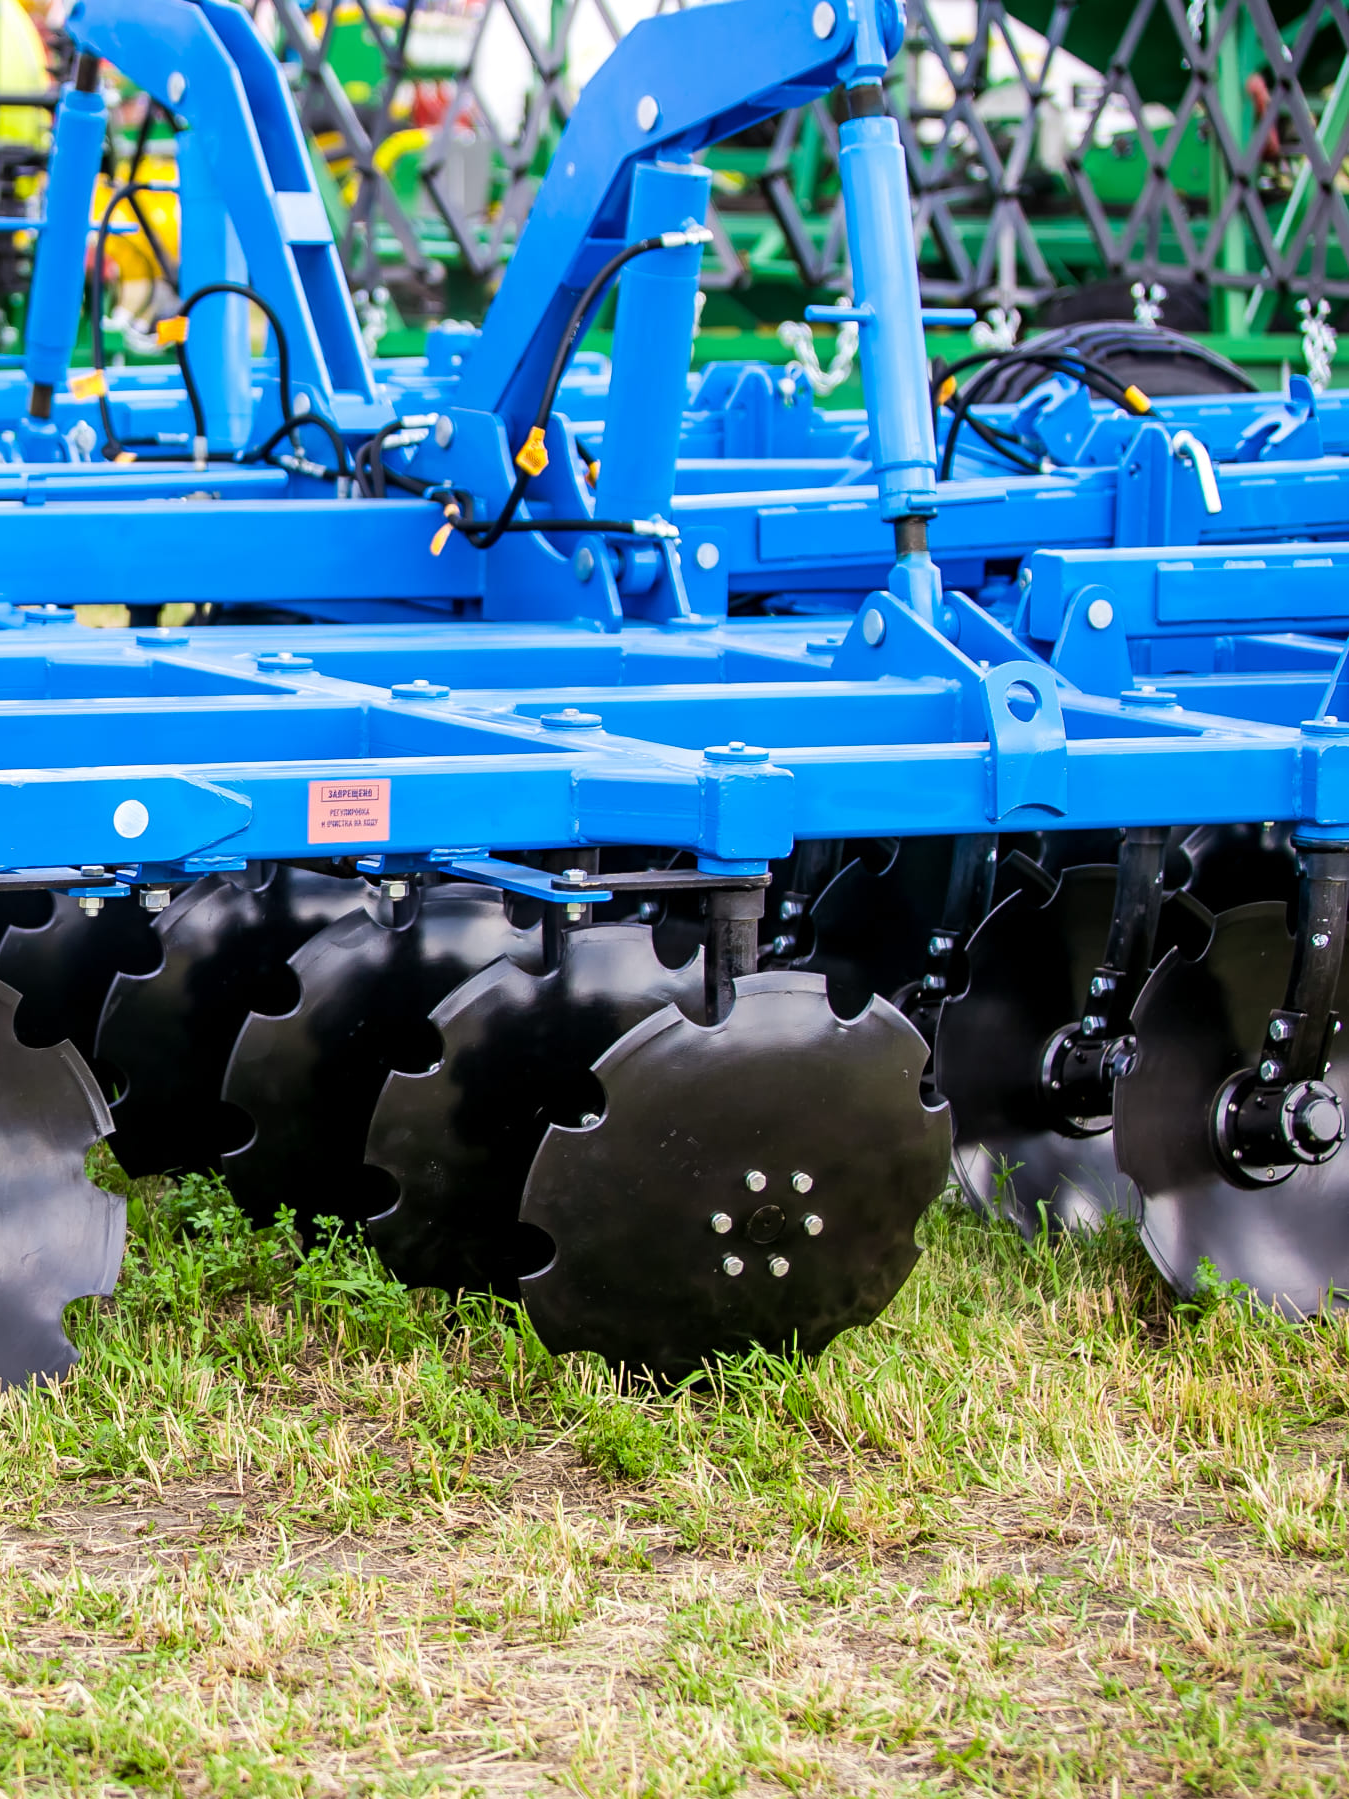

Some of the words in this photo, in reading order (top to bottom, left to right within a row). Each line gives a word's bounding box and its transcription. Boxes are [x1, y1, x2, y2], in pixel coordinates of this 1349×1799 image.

[328, 788, 372, 799] ЗАПРЕЩЕНО
[330, 808, 369, 816] РЕГУЛИРОВКА
[327, 819, 352, 827] ОЧИСТКА
